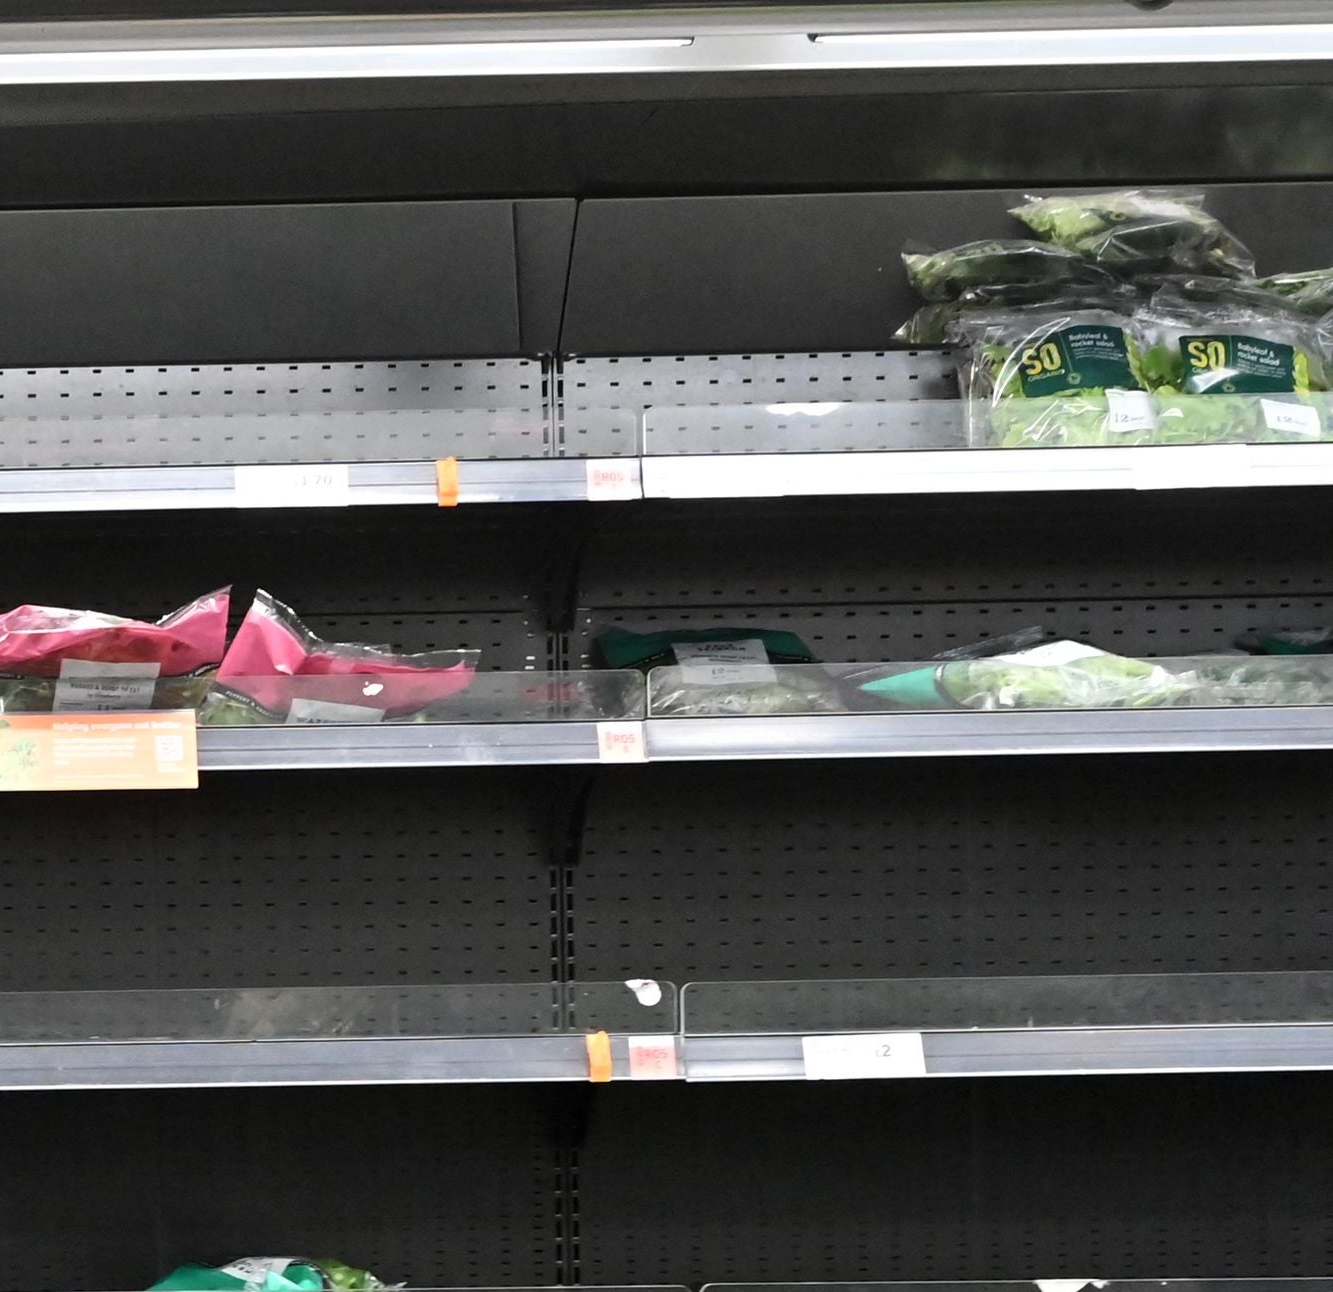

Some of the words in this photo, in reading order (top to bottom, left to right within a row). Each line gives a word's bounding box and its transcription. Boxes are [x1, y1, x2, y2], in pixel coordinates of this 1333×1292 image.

[1069, 332, 1102, 341] Babyleaf
[1188, 341, 1226, 371] SO
[1237, 342, 1268, 357] Babyleaf
[1022, 342, 1062, 375] SO
[1237, 351, 1258, 361] rocket
[1259, 357, 1280, 366] salad
